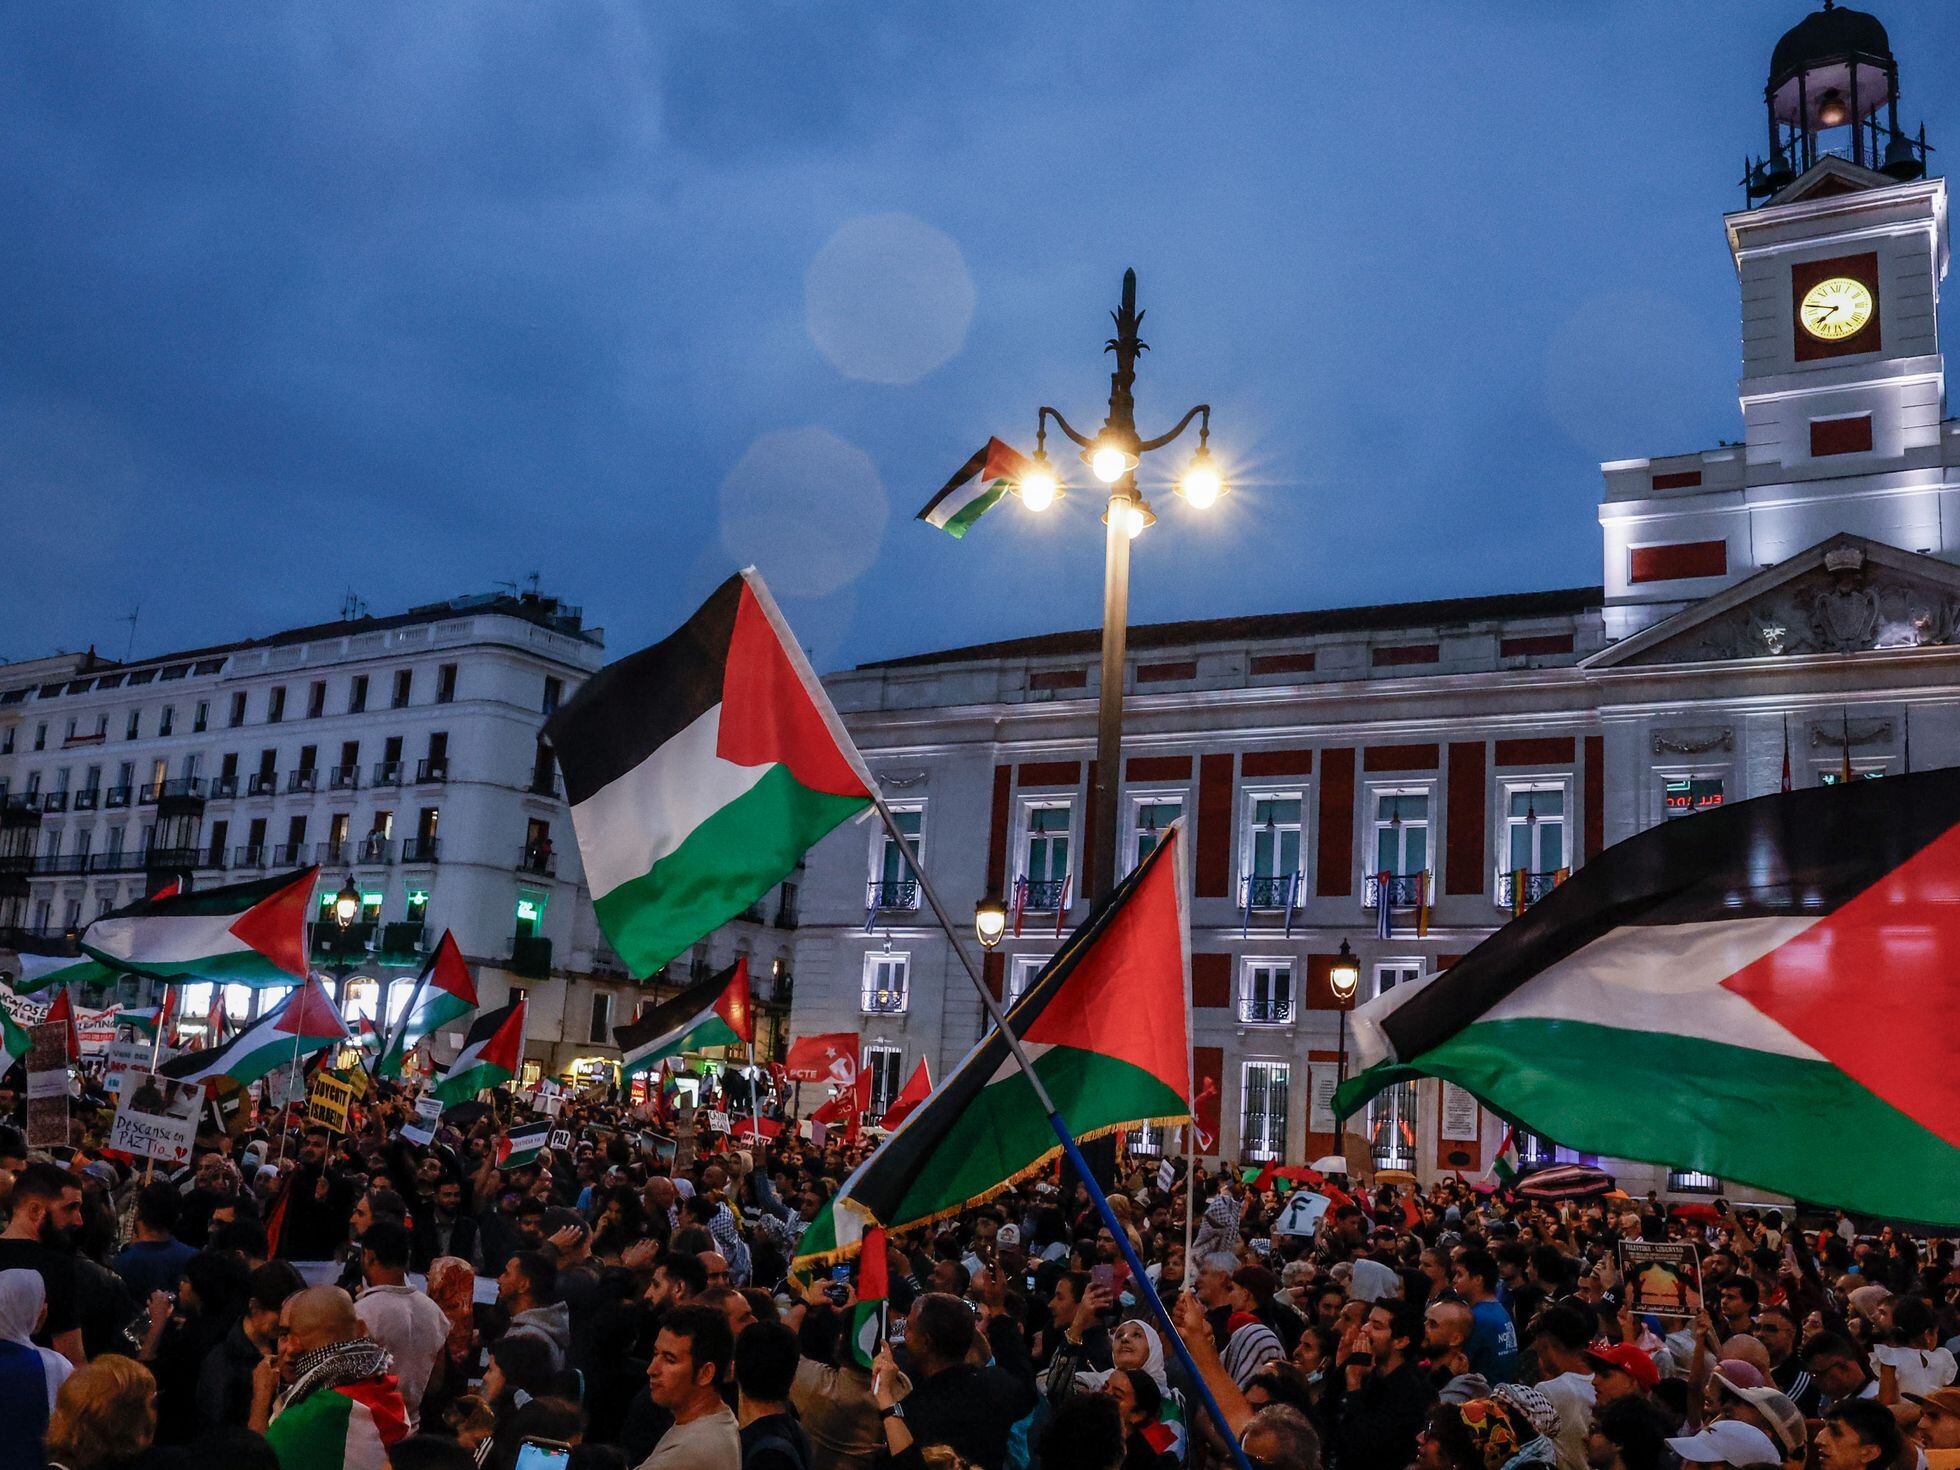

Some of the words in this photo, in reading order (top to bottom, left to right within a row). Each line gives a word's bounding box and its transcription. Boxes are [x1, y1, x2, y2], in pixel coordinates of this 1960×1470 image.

[789, 1069, 818, 1079] PCTE
[313, 1079, 349, 1107] BOYCOTT
[119, 1131, 144, 1149] PAZ
[173, 1133, 184, 1143] en
[553, 1131, 569, 1145] PAZ
